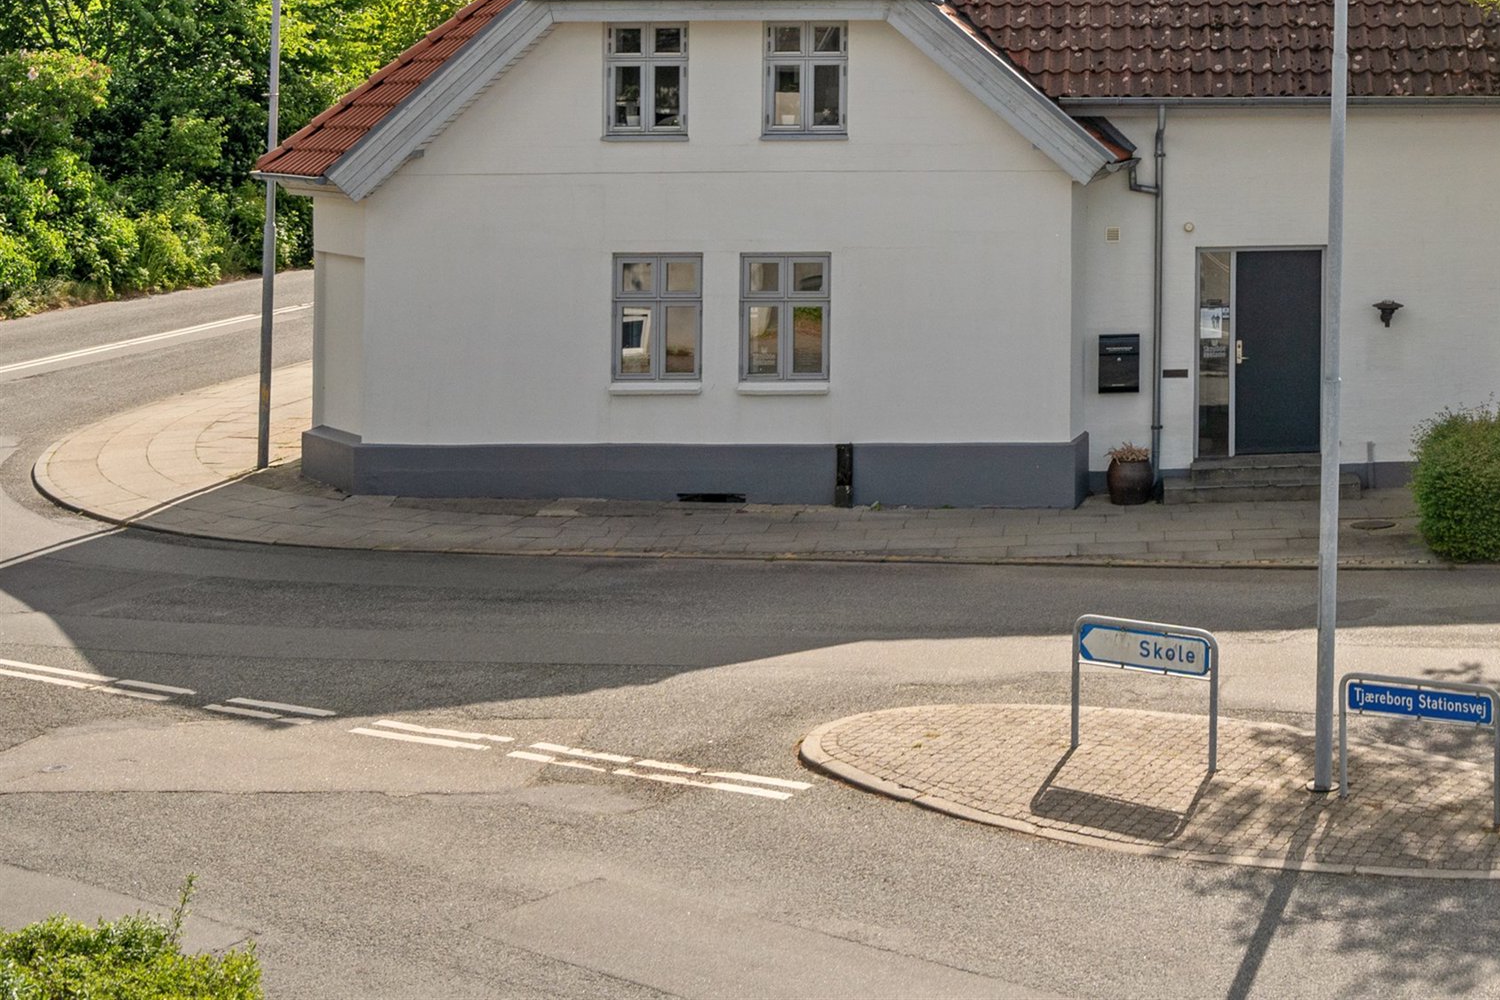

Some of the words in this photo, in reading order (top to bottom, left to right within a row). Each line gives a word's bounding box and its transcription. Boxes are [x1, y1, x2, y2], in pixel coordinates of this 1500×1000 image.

[1139, 640, 1196, 664] Skole
[1354, 687, 1413, 712] Tjæreborg
[1418, 694, 1487, 719] Stationsvej
